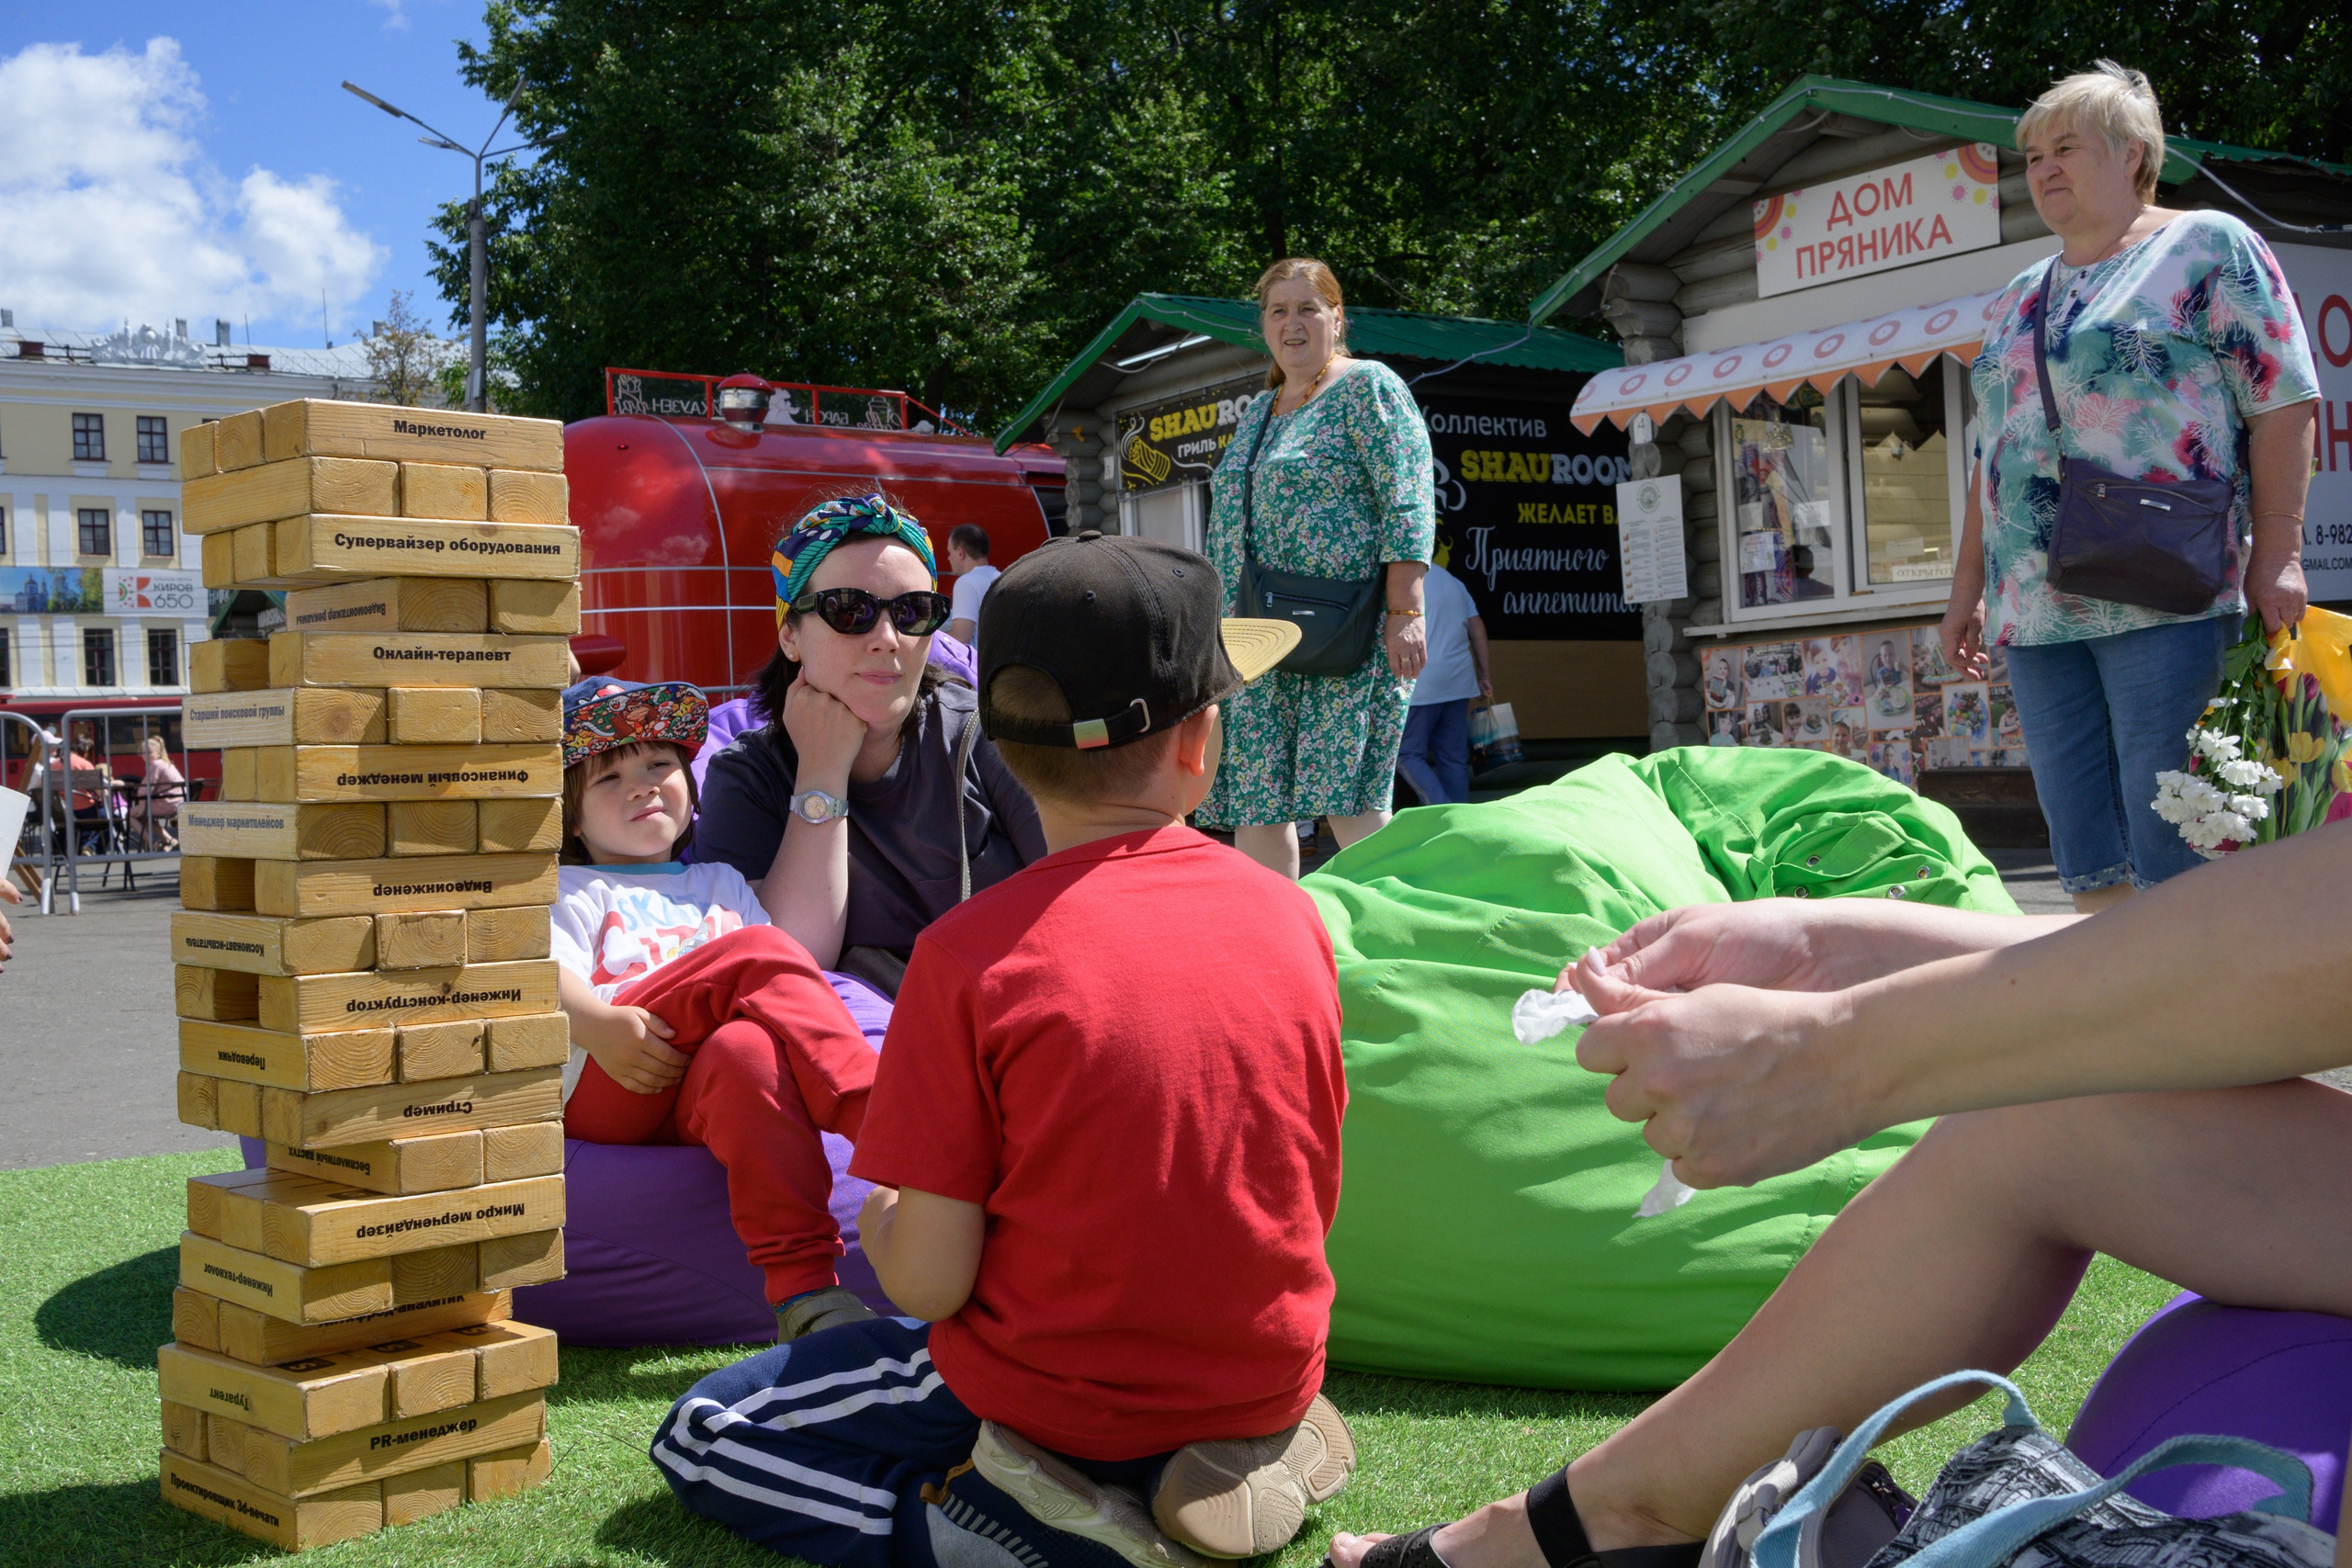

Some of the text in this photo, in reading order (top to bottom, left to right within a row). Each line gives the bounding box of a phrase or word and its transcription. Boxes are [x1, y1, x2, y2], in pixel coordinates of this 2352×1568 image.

[1826, 172, 1913, 231] ДОМ
[1796, 213, 1953, 279] ПРЯНИКА
[393, 420, 487, 440] Маркетолог
[1177, 438, 1216, 458] ГРИЛЬ
[1518, 502, 1597, 525] ЖЕЛАЕТ
[334, 533, 561, 555] Супервайзер оборудования
[1465, 525, 1610, 592] Приятного
[1896, 568, 1948, 578] ОТКРЫТО
[153, 582, 193, 592] КИРОВ
[154, 593, 194, 609] 650
[296, 609, 326, 625] рекламы
[328, 603, 386, 620] Видеомонтажер
[373, 647, 512, 663] Онлайн-терапевт
[189, 704, 285, 723] Старший поисковой группы
[336, 770, 529, 788] Финансовый менеджер
[188, 814, 285, 830] Менеджер маркетплейсов
[372, 880, 492, 897] Видеоинженер
[186, 938, 265, 957] Космонавт-испытатель
[345, 988, 521, 1013] Инженер-конструктор
[218, 1050, 266, 1070] Переводчик
[403, 1100, 473, 1118] Стример
[316, 1152, 370, 1176] Беспилотный
[356, 1203, 526, 1239] Микро мерчендайзер
[204, 1263, 273, 1298] Инженер-технолог
[209, 1387, 250, 1412] Турагент
[370, 1418, 477, 1450] PR-менеджер
[171, 1472, 279, 1527] Проектировщик 3d-печати
